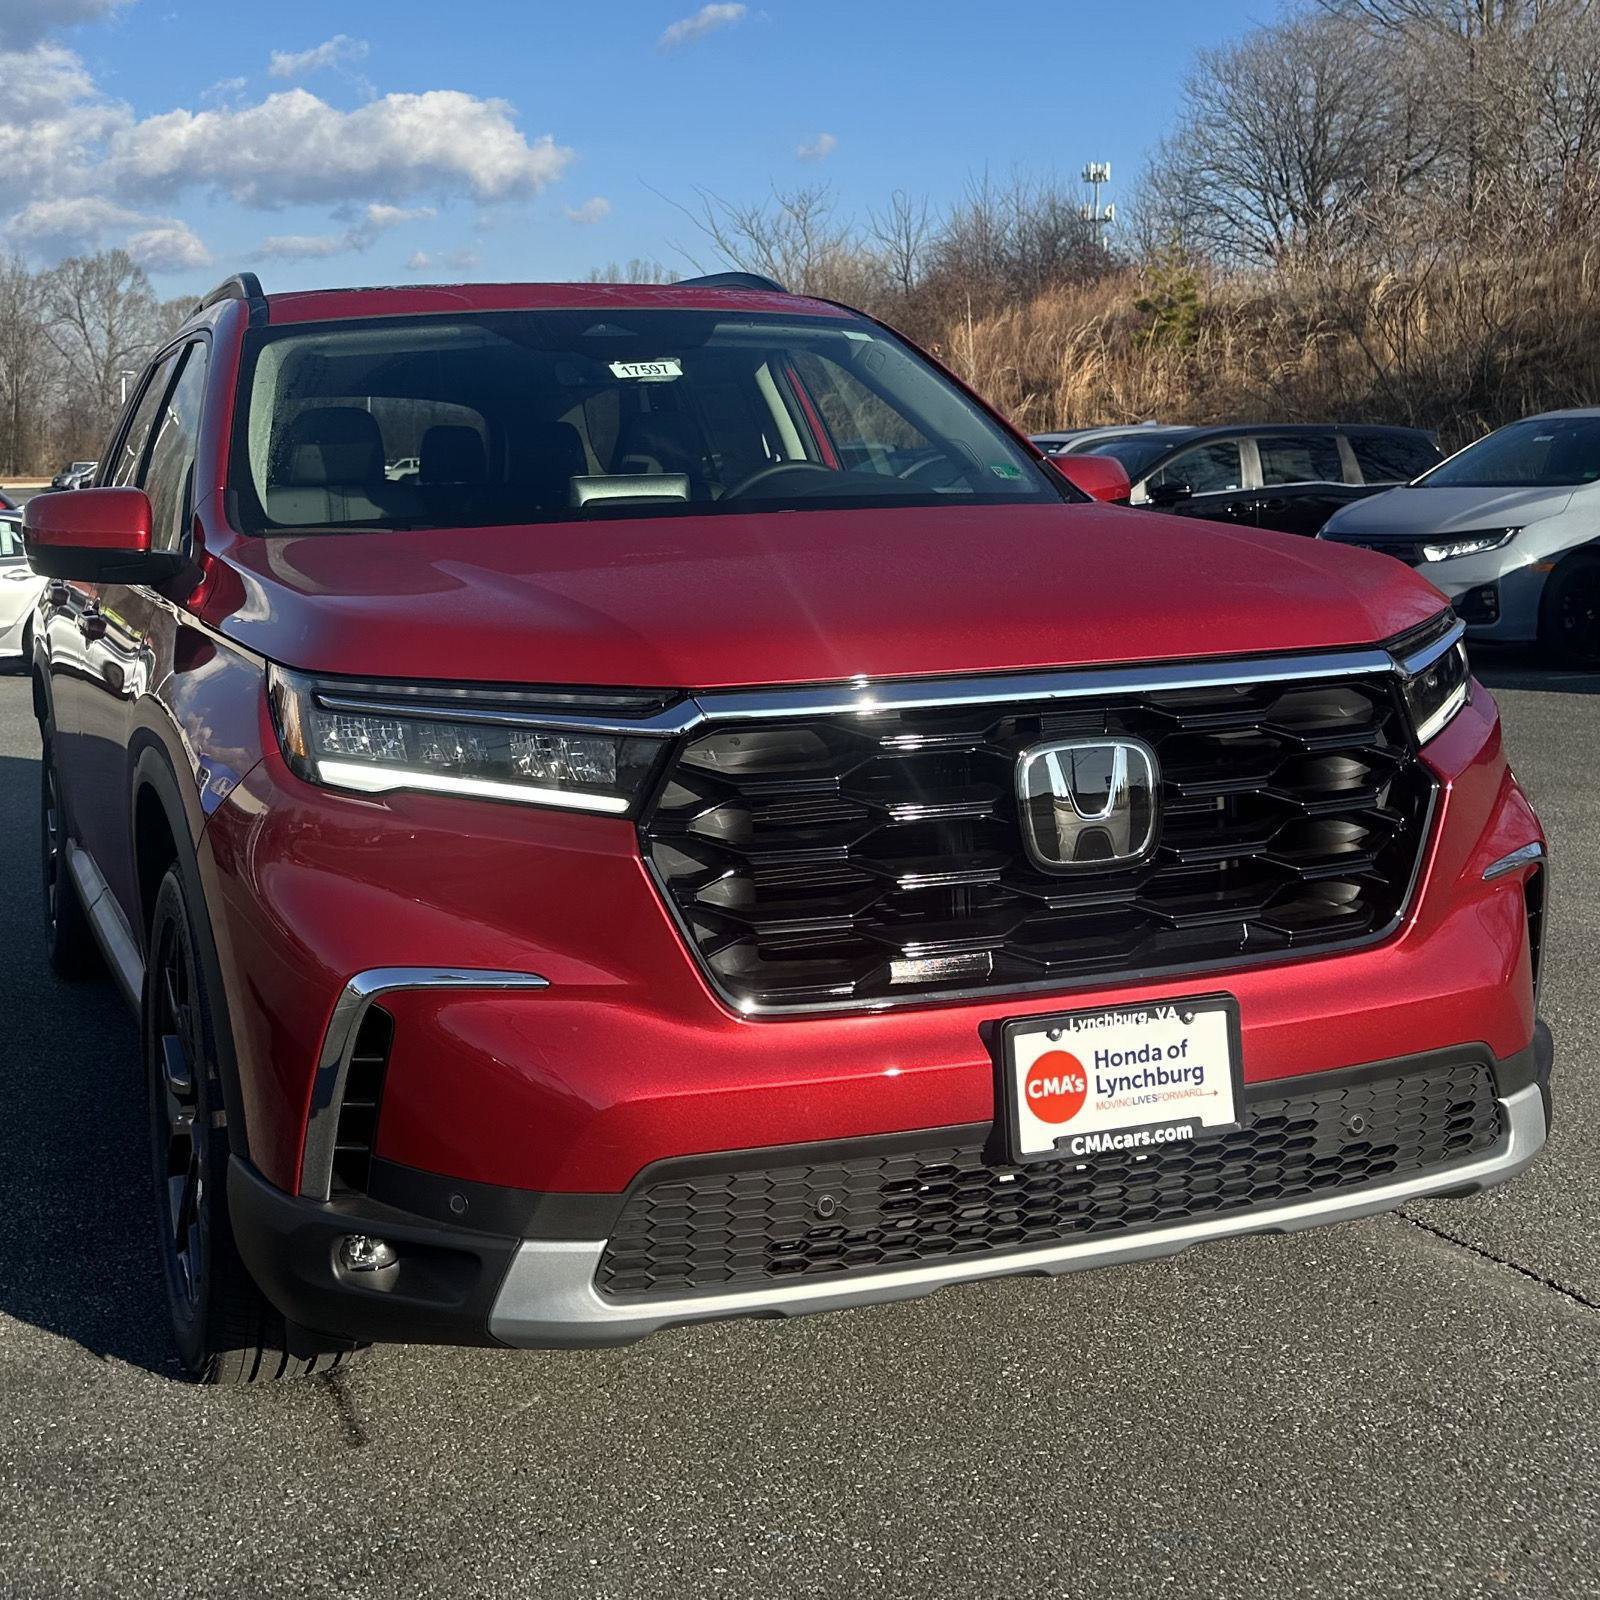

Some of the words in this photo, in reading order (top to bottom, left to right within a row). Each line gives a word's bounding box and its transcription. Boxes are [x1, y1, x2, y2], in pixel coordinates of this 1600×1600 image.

[621, 364, 668, 376] 17597
[1155, 1006, 1177, 1021] VA
[1094, 1044, 1162, 1069] Honda
[1168, 1039, 1188, 1059] of
[1028, 1074, 1084, 1098] CMA's
[1096, 1065, 1205, 1098] Lynchburg
[1071, 1124, 1193, 1155] CMAcars.com
